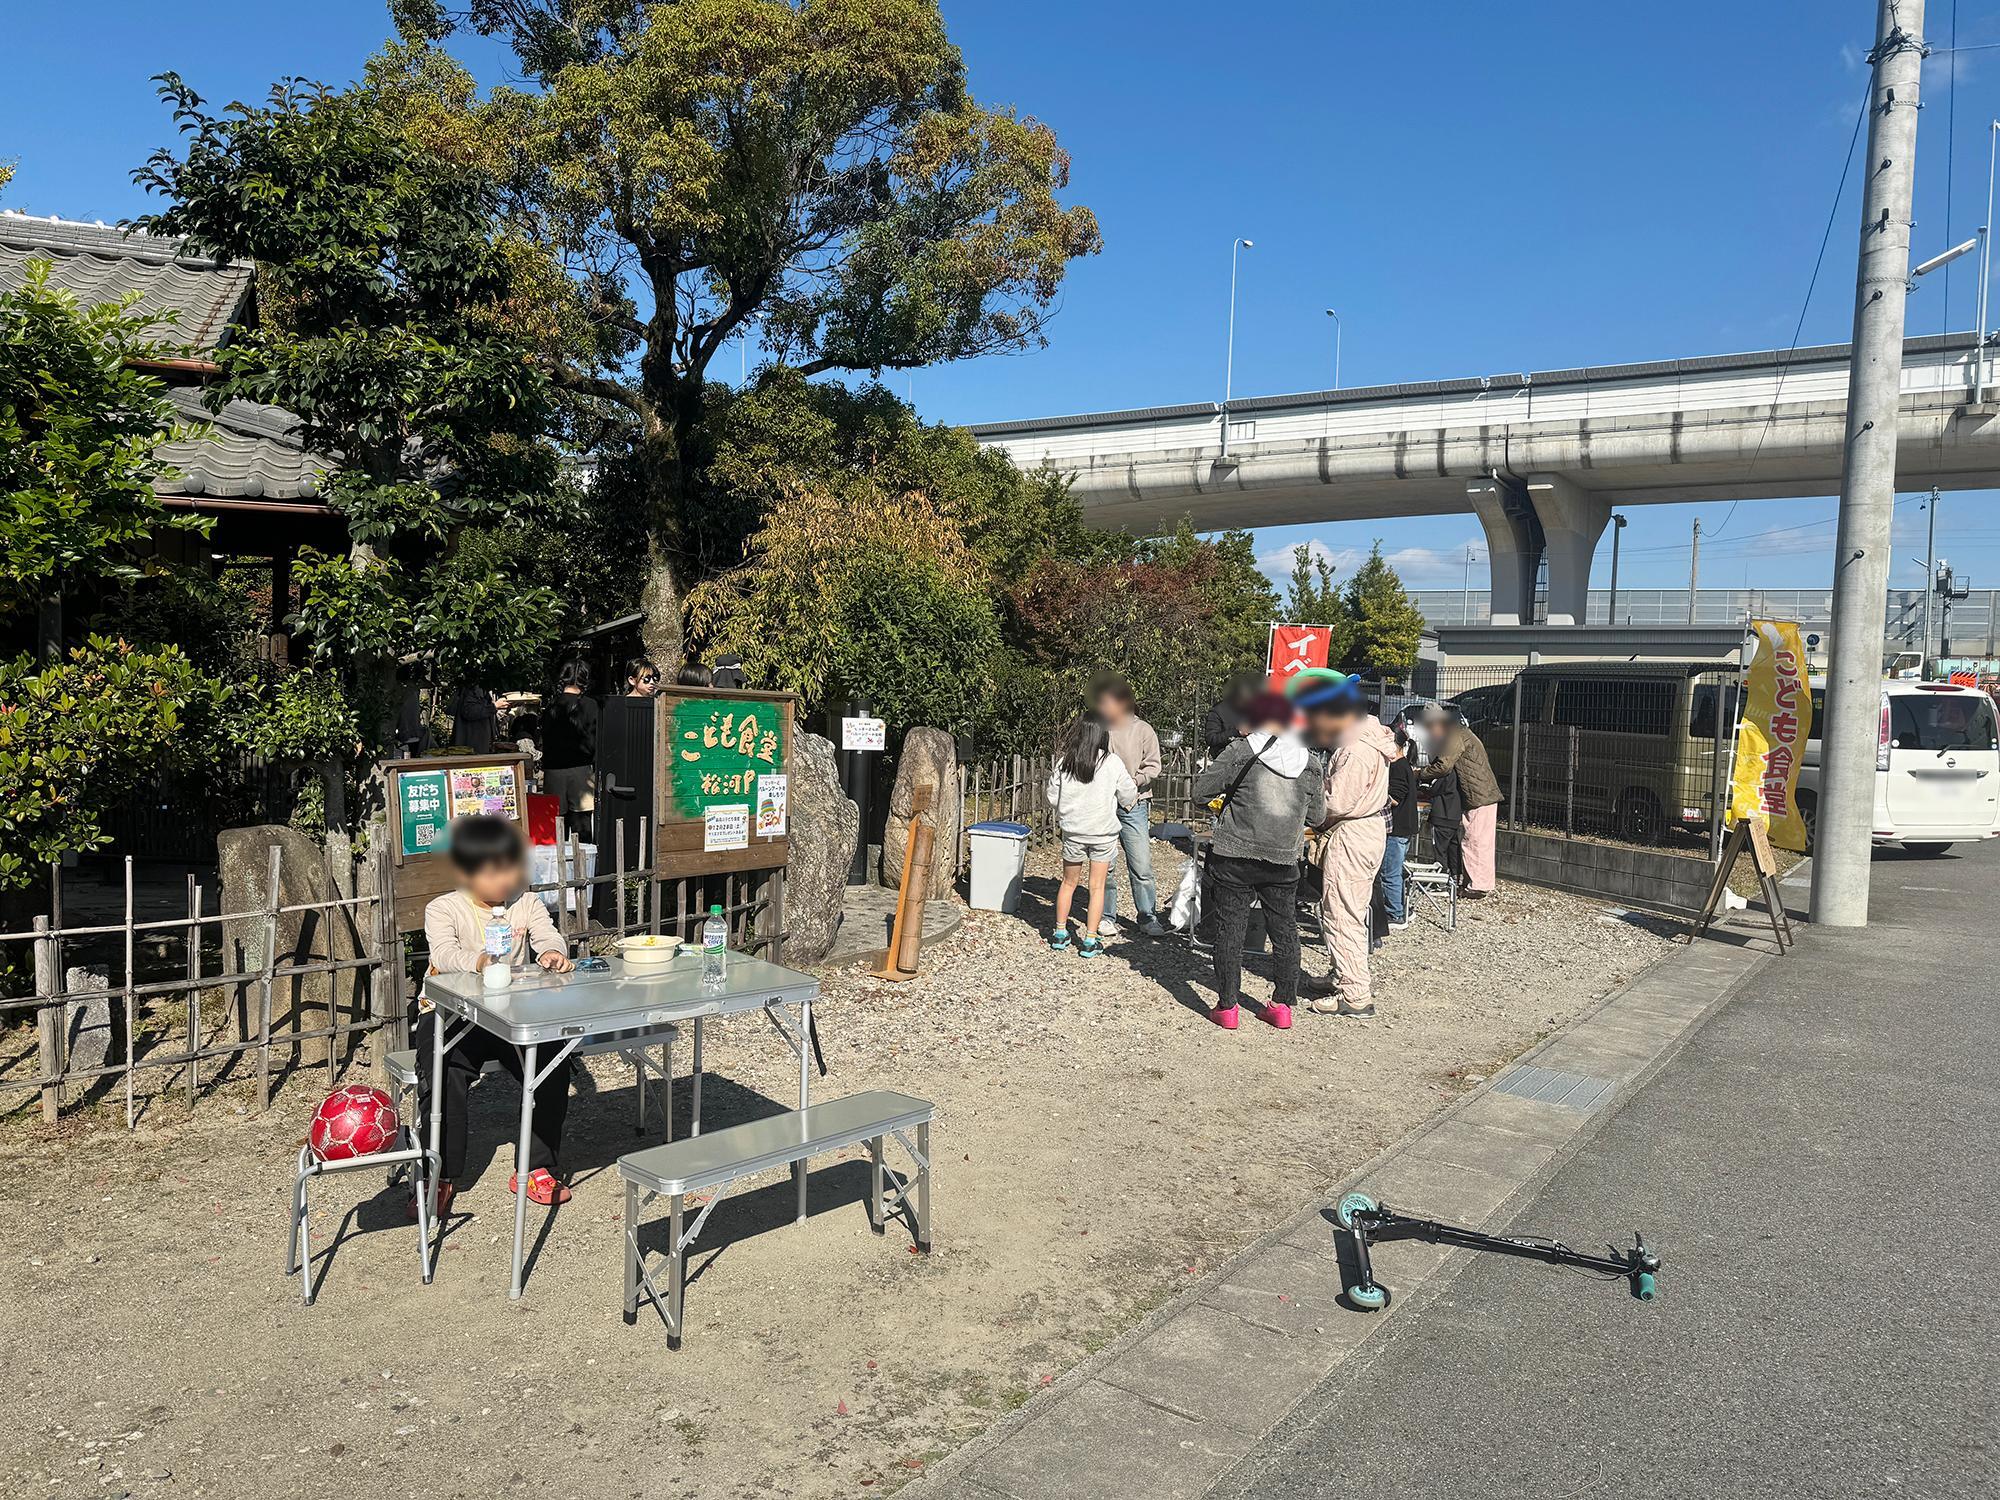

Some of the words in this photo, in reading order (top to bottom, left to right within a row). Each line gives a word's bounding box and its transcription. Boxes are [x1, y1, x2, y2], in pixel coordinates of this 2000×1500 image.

[681, 711, 777, 765] こども食堂
[407, 783, 439, 798] 友だち
[408, 798, 440, 813] 募集中
